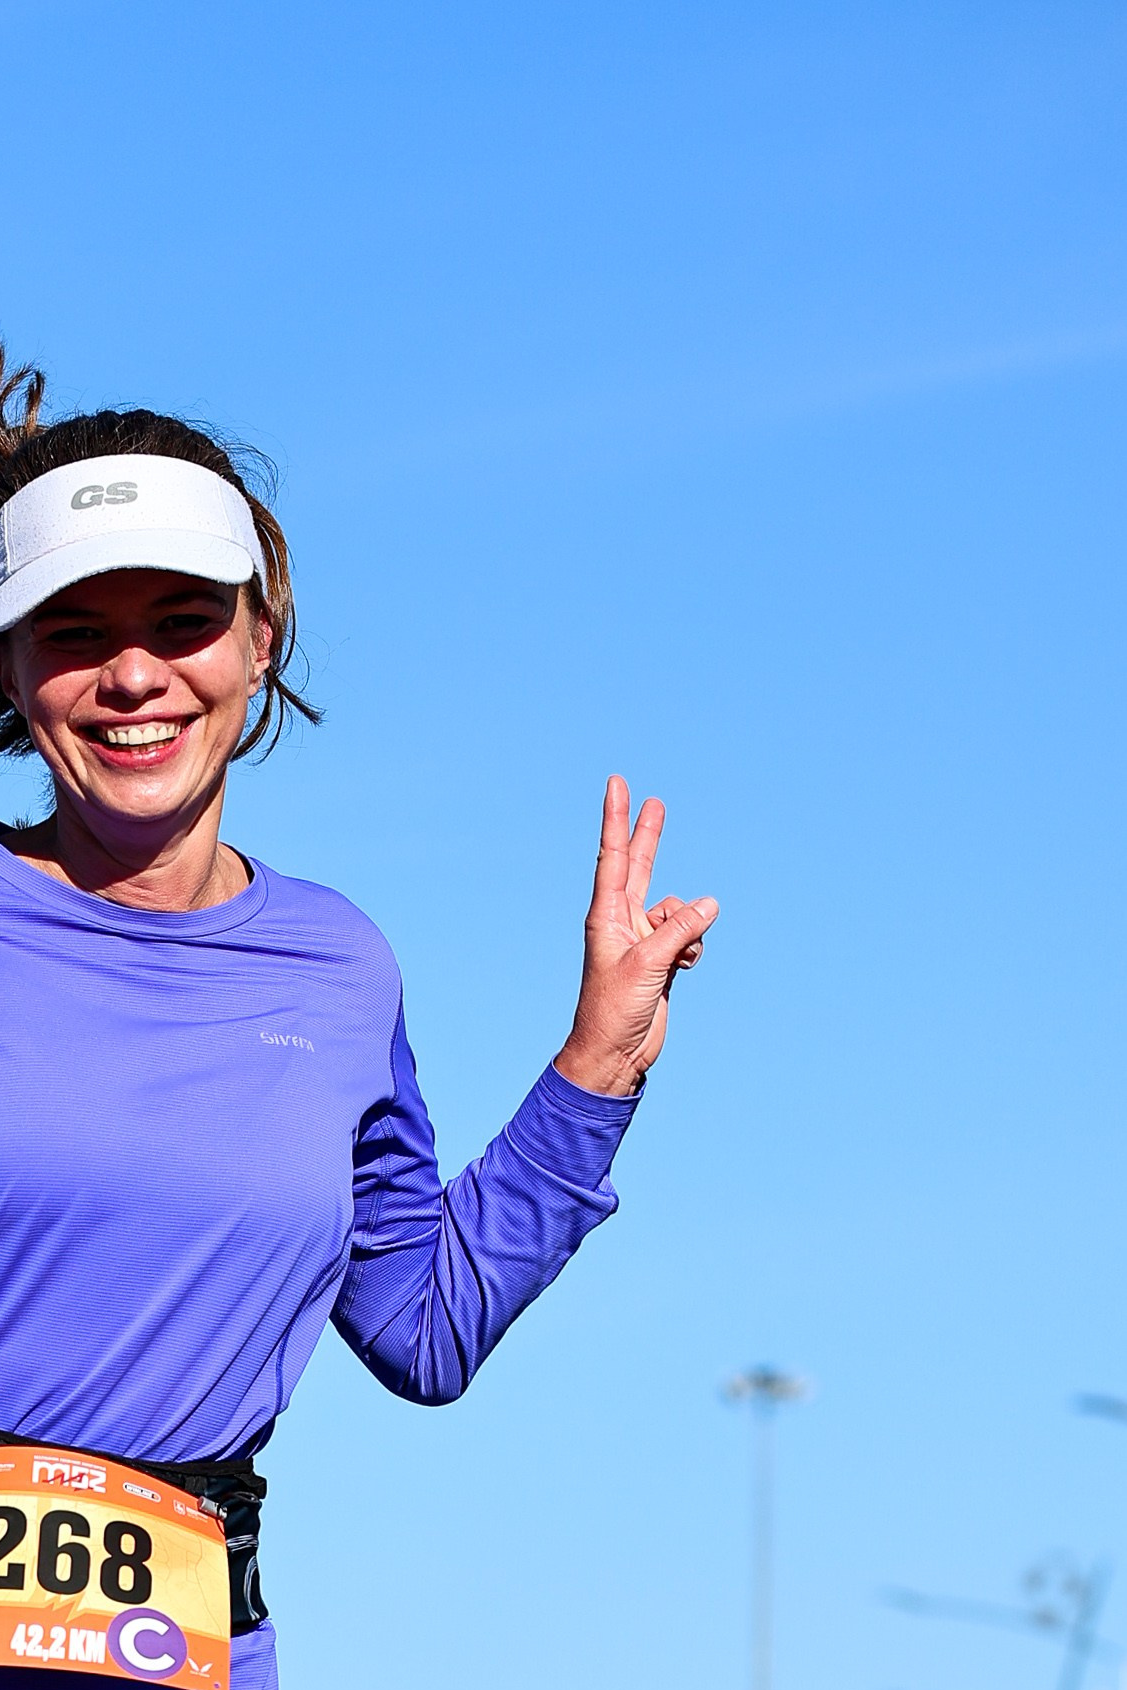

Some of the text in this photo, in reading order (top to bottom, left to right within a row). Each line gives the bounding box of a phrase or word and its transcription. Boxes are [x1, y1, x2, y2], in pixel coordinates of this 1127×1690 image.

[71, 481, 138, 510] GS
[10, 1623, 107, 1664] 42,2 KM
[118, 1616, 176, 1672] C
